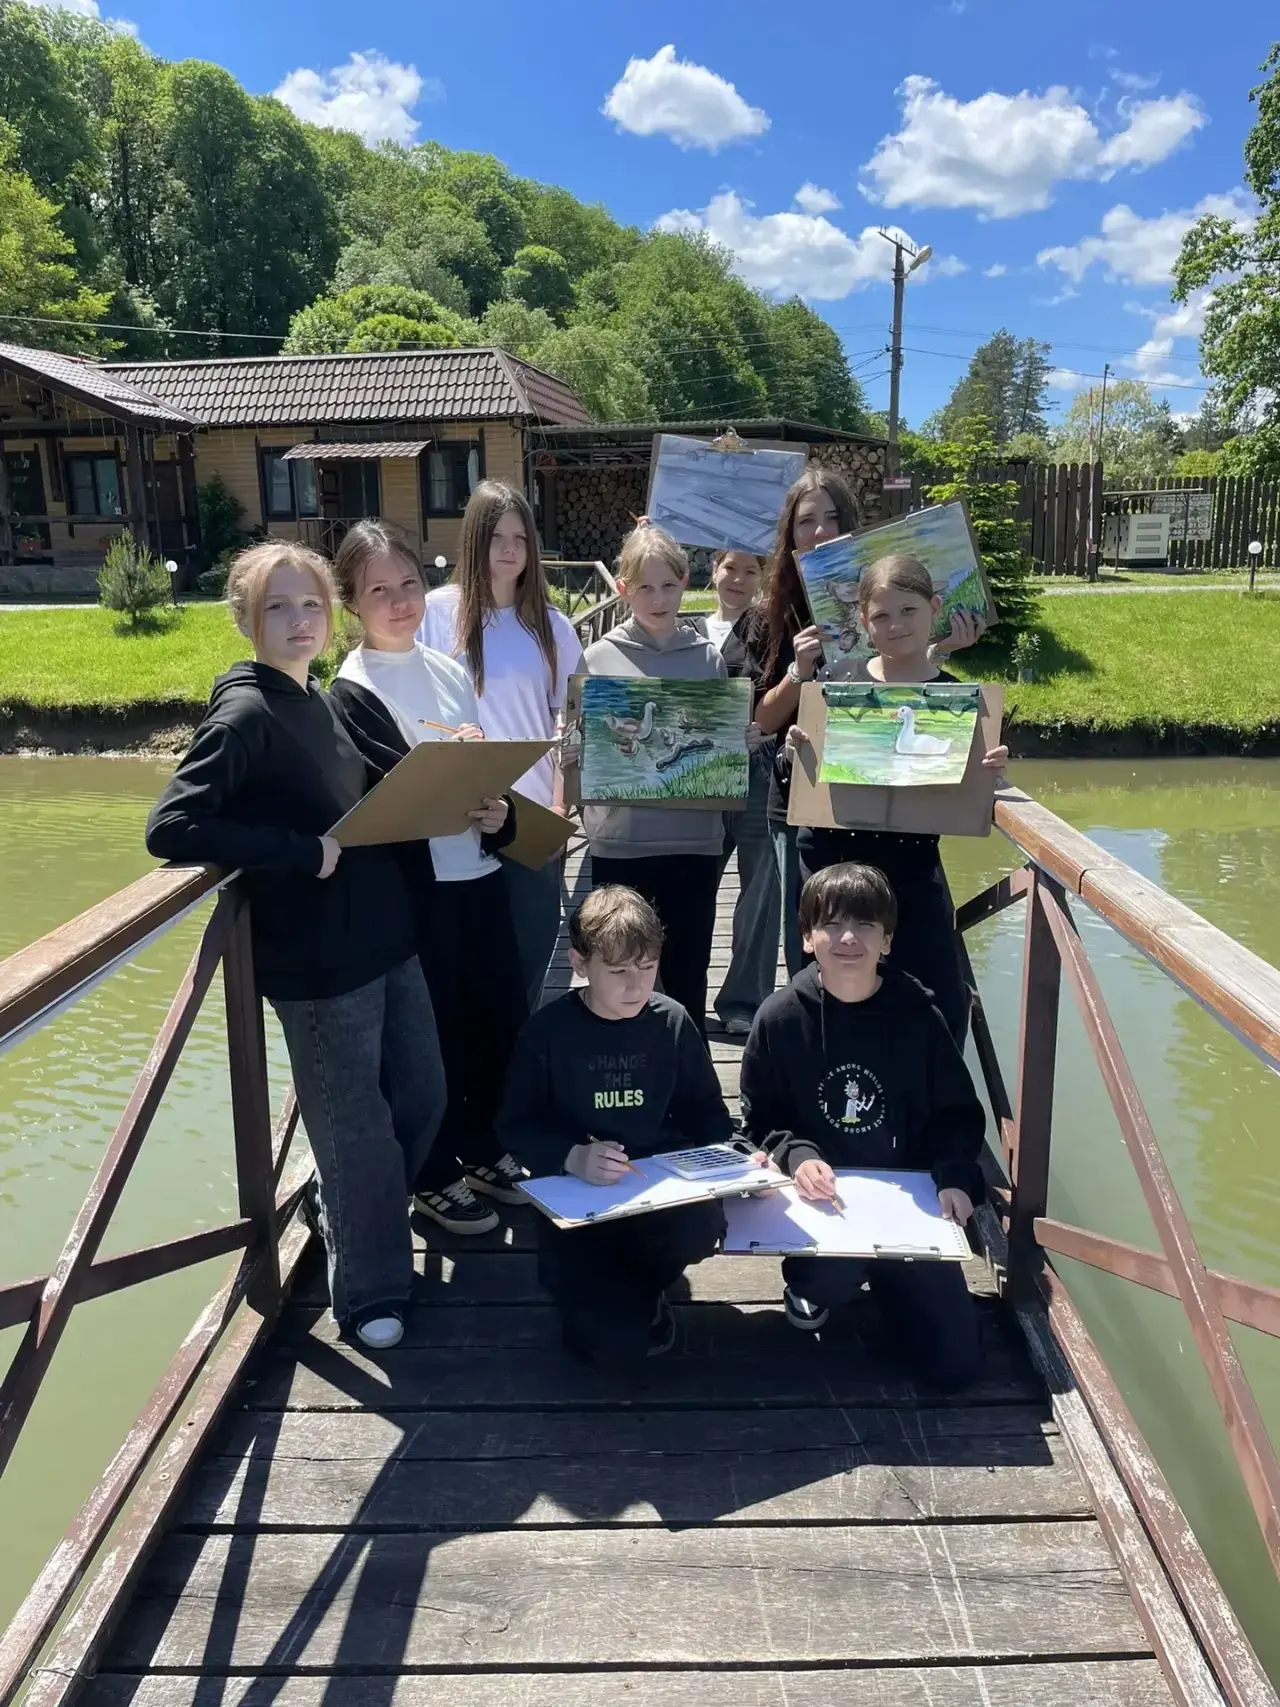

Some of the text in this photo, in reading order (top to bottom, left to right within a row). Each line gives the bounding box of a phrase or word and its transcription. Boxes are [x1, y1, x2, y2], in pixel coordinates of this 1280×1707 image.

[836, 1063, 861, 1073] AMONG
[604, 1072, 632, 1088] THE
[594, 1089, 644, 1109] RULES
